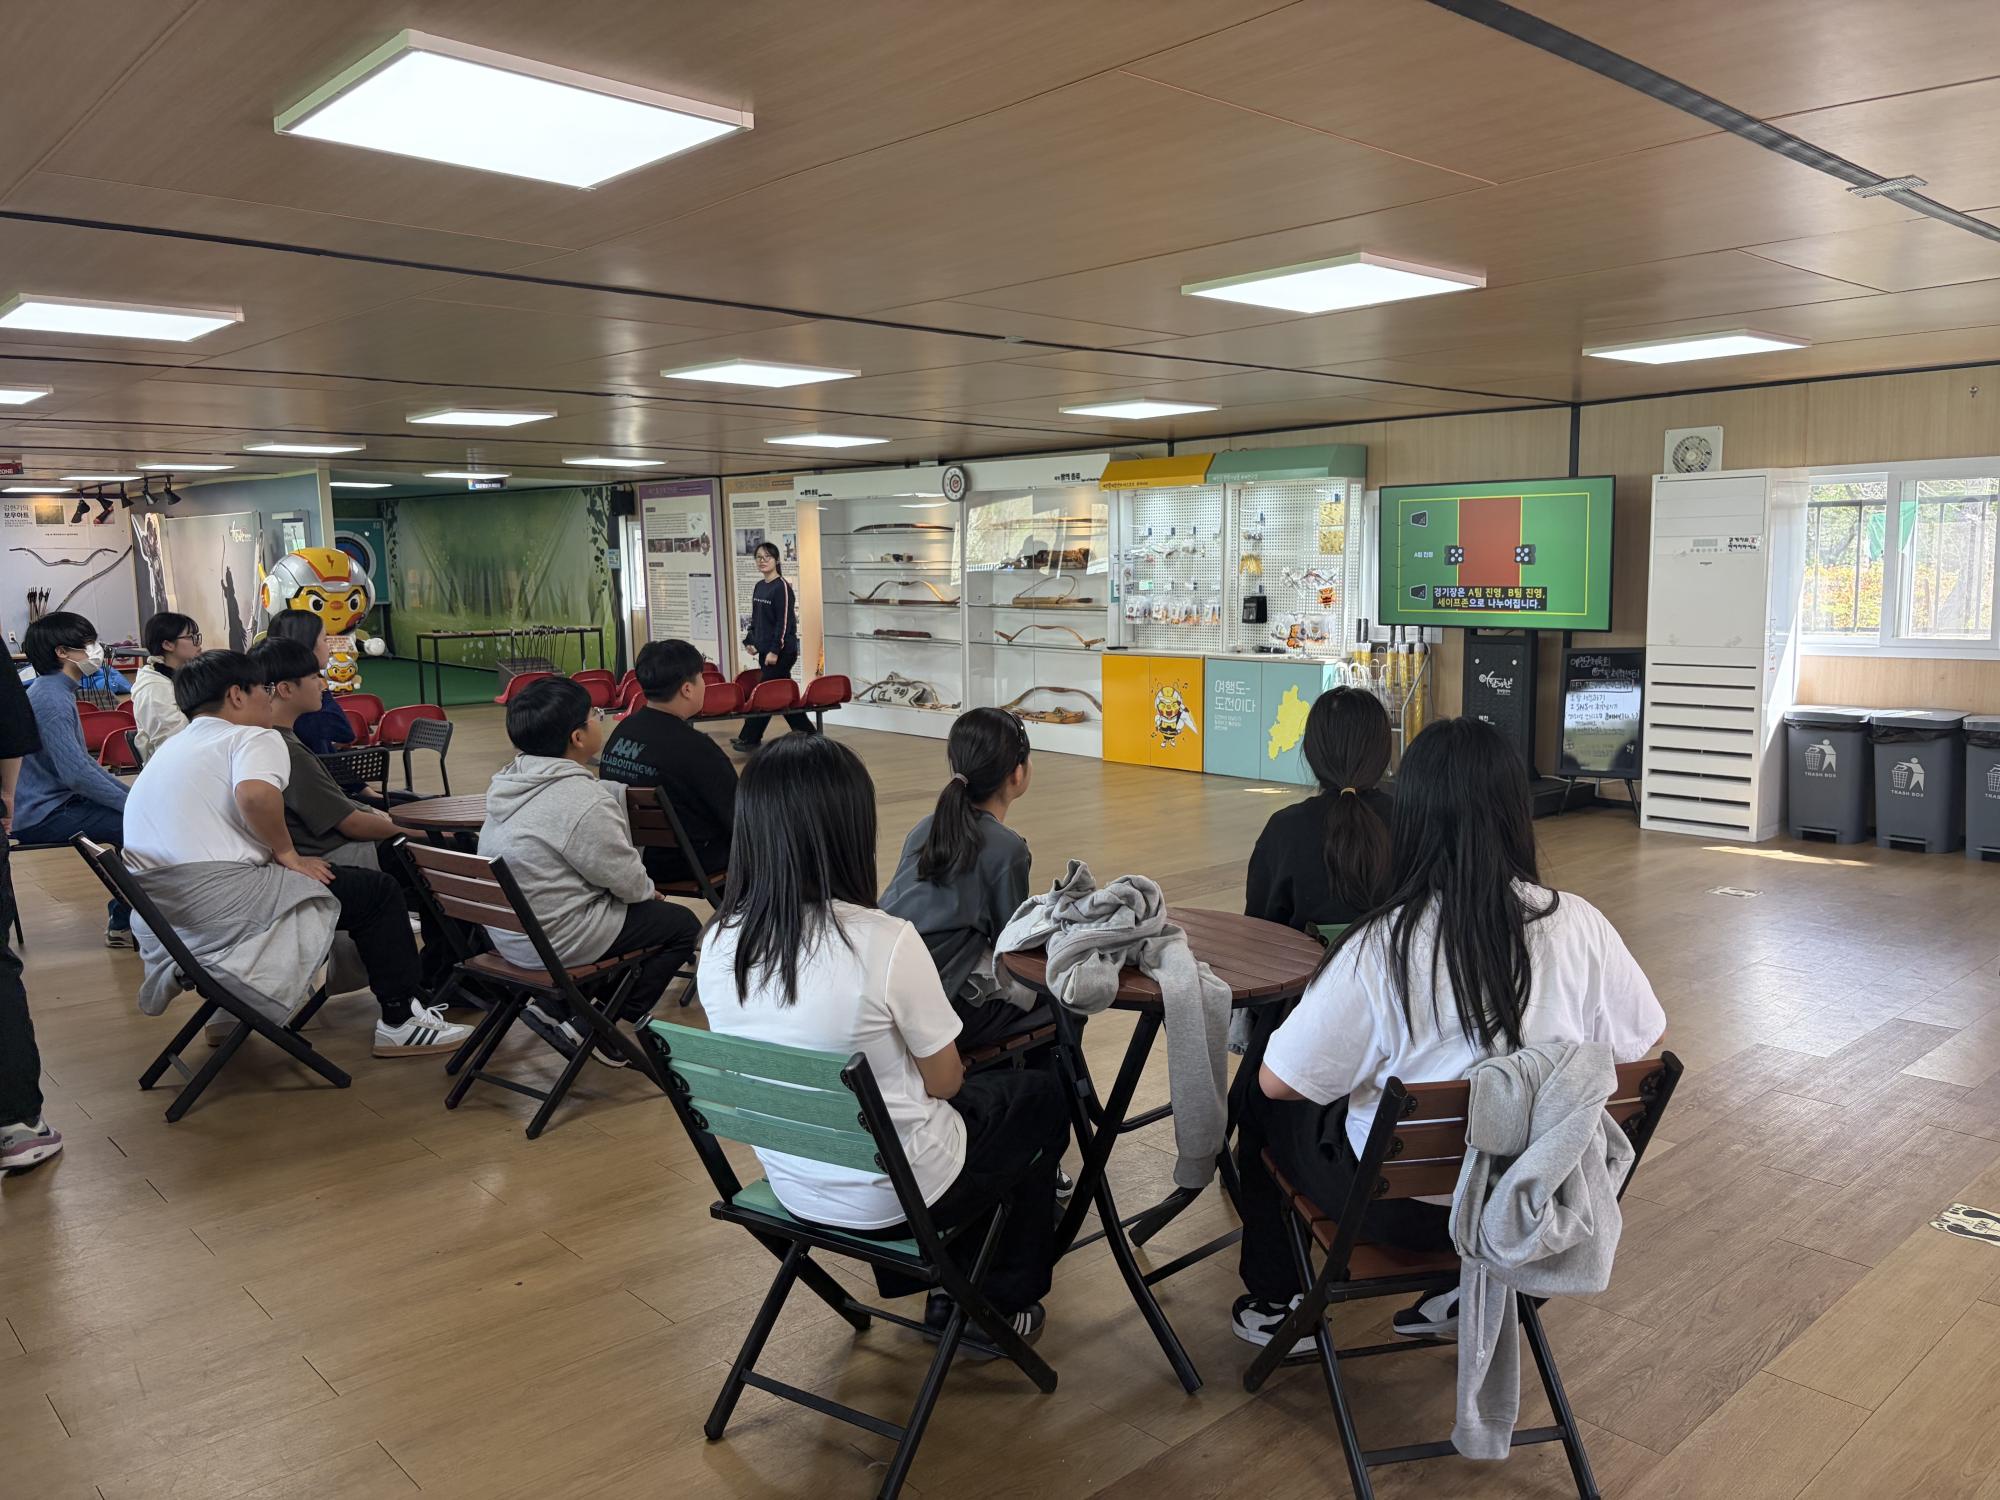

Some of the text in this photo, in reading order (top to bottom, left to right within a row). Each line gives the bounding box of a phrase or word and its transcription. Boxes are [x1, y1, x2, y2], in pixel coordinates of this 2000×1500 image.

[1434, 587, 1545, 599] 경기장은 A팀 진영, B팀 진영,
[1437, 598, 1541, 609] 세이프존으로 나누어집니다.
[1214, 696, 1256, 713] 도전이다
